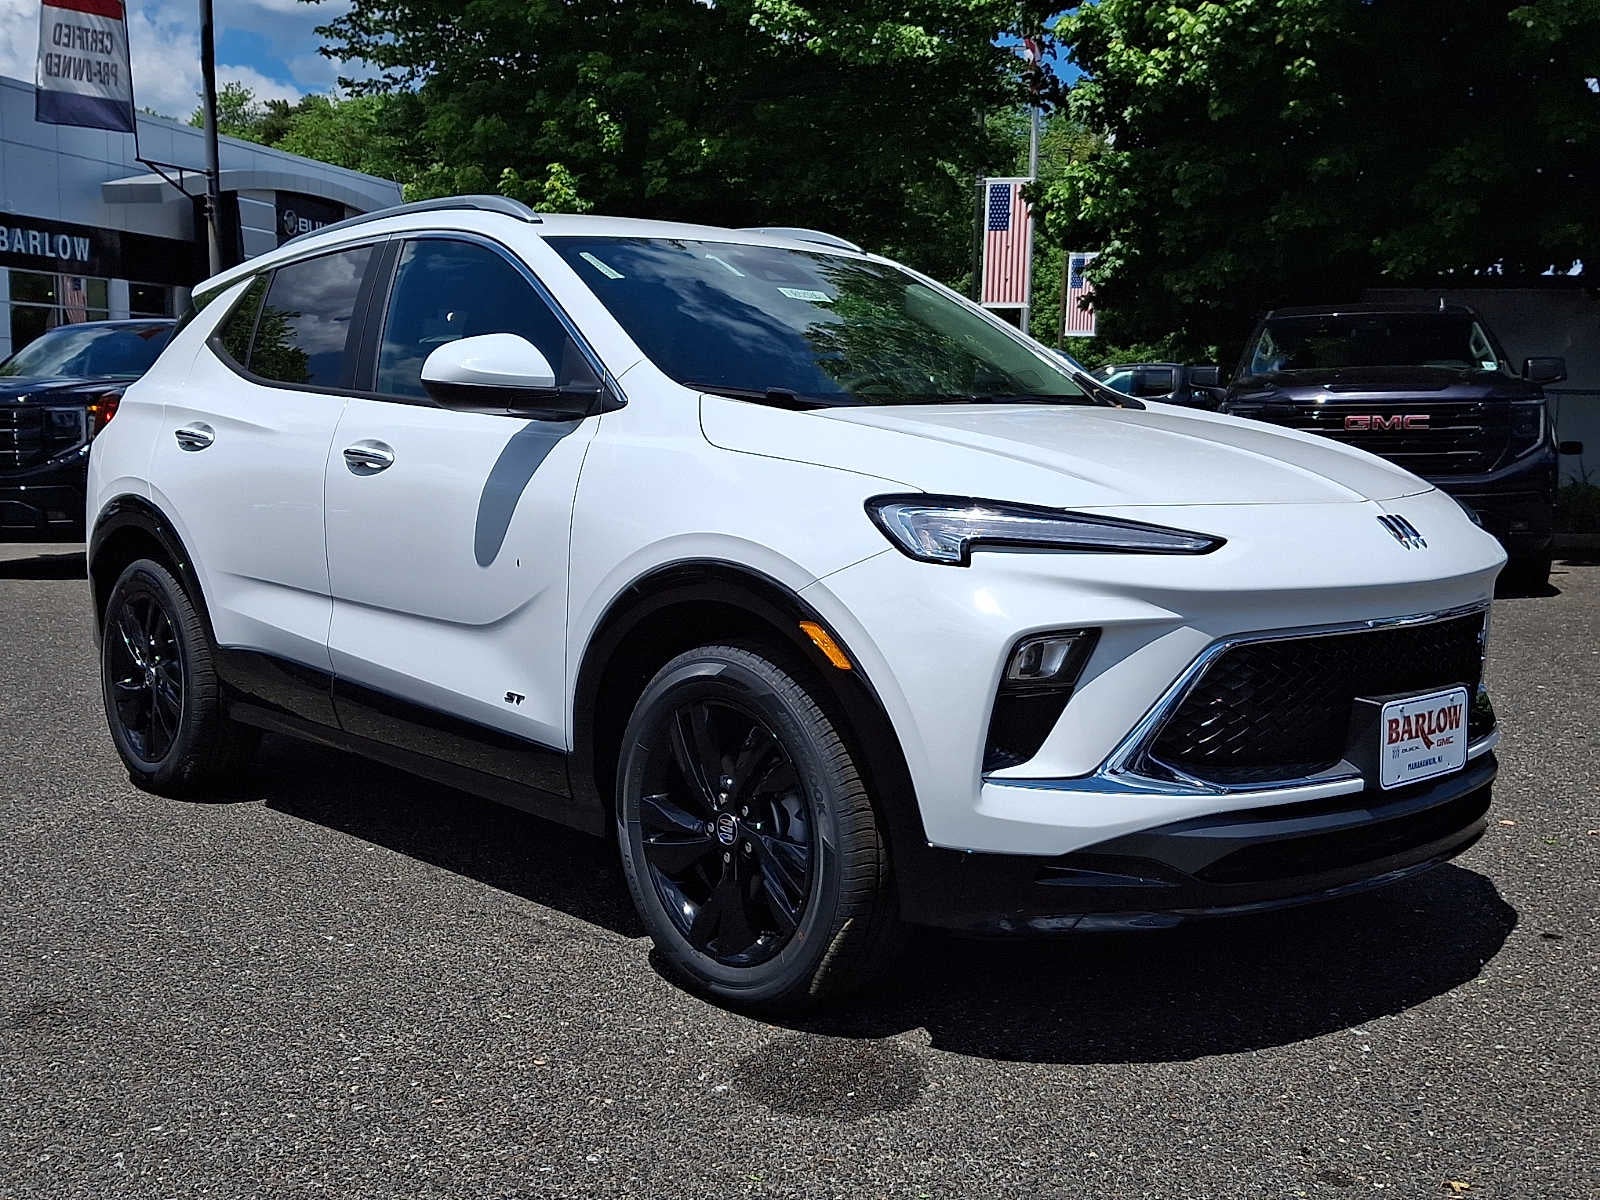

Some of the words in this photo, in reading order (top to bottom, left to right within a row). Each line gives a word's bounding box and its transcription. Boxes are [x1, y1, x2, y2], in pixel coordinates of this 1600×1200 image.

[298, 217, 329, 232] BUI
[0, 226, 90, 262] BARLOW
[1344, 415, 1430, 430] GMC
[503, 691, 526, 706] ST
[1387, 704, 1463, 750] BARLOW
[1436, 735, 1454, 747] GMC
